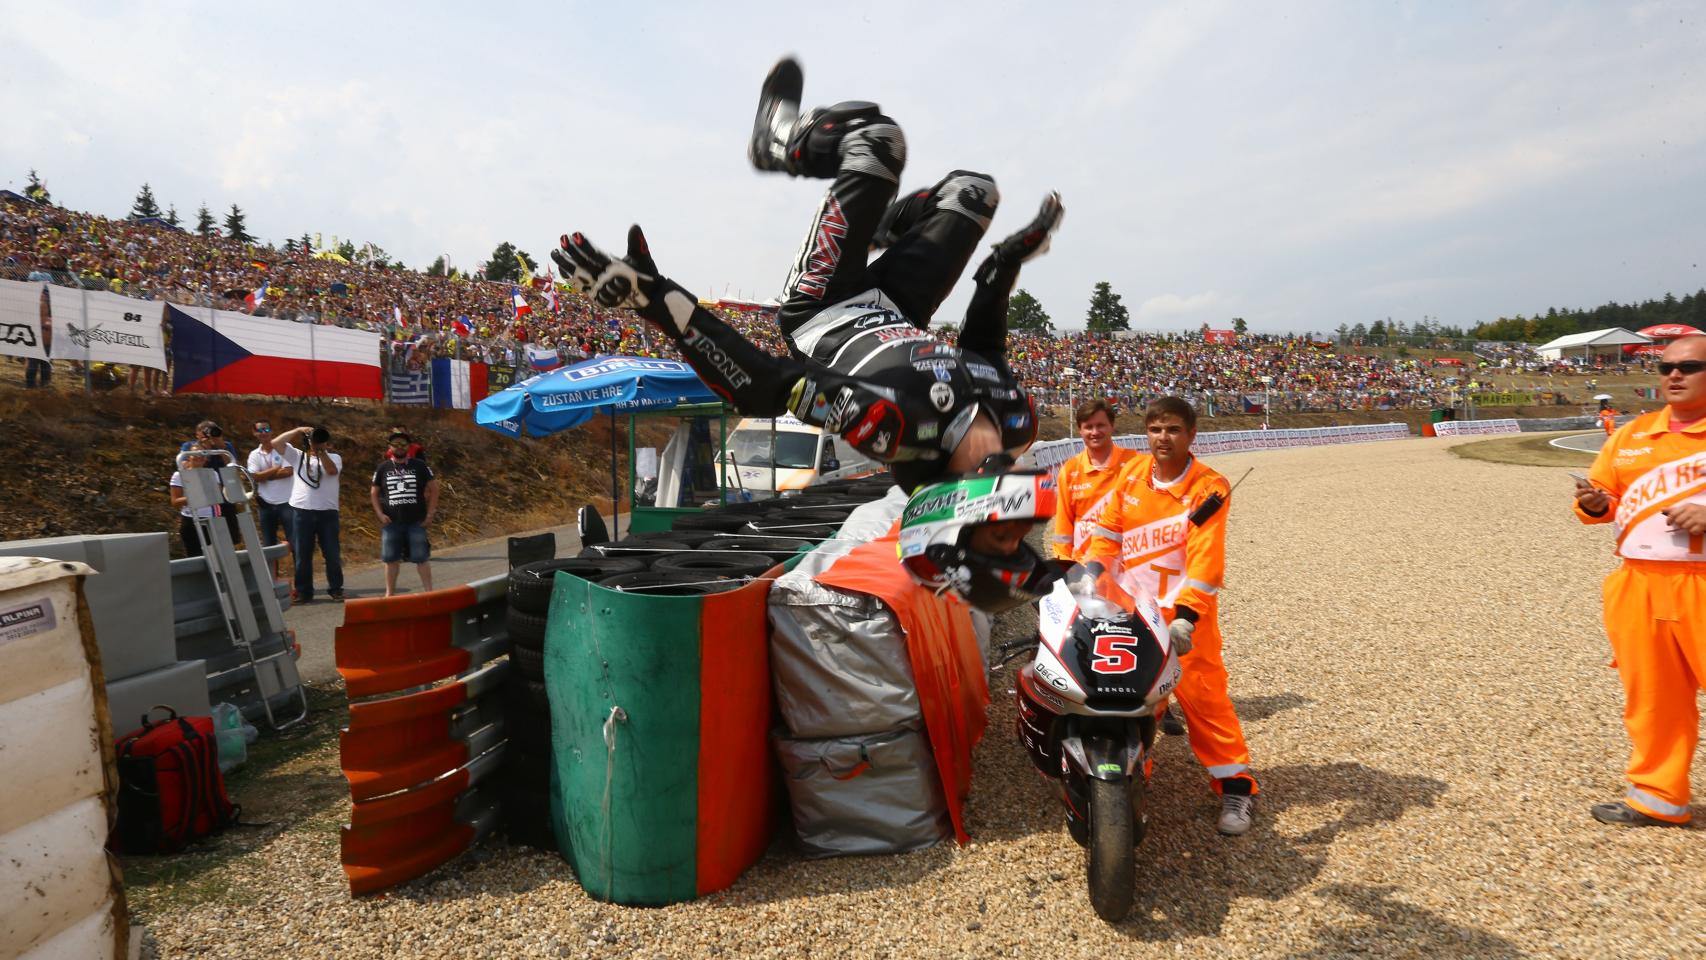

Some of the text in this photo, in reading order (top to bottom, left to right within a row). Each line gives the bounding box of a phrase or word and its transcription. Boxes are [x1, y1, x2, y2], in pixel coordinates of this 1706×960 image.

[797, 194, 849, 301] AVANT
[123, 312, 142, 323] 84
[579, 361, 676, 377] BIRELL
[496, 373, 510, 384] 20
[585, 389, 599, 400] VE
[602, 384, 624, 398] HŘE
[389, 498, 417, 507] Reebok
[1150, 564, 1181, 600] T
[1, 607, 41, 623] ALPINA
[1091, 634, 1138, 674] 5
